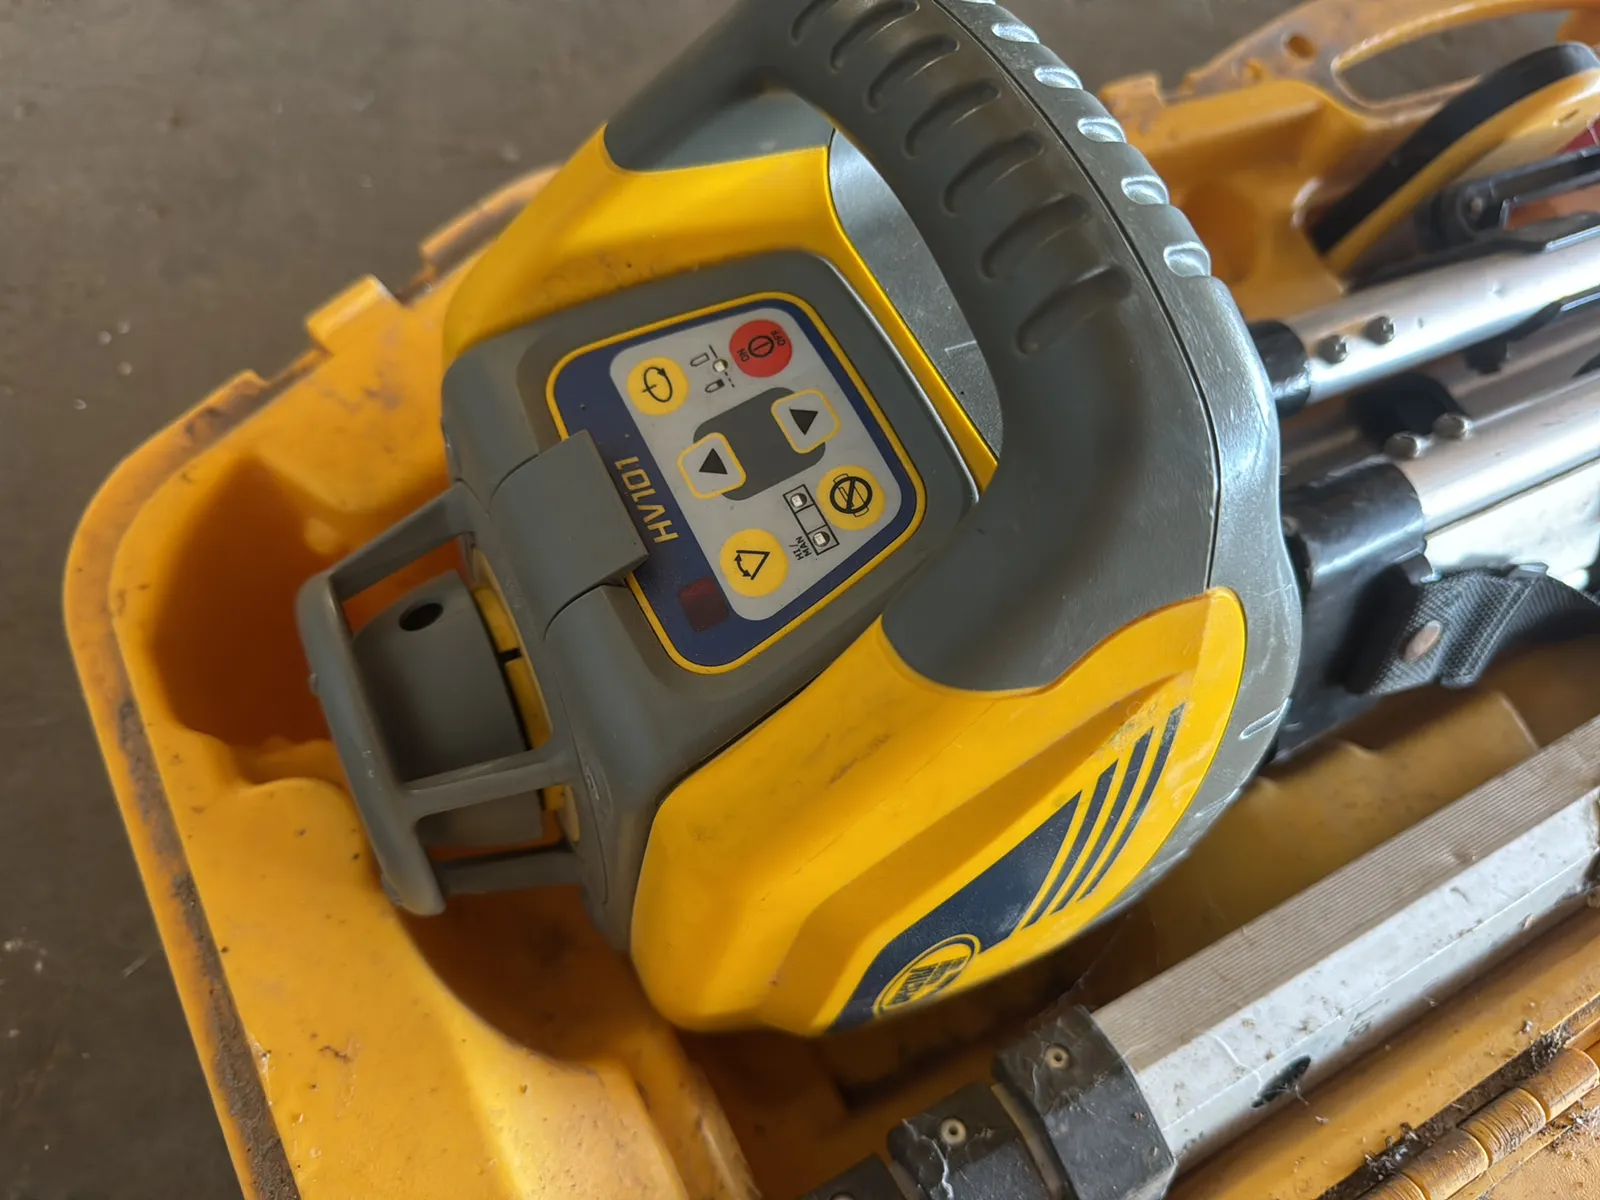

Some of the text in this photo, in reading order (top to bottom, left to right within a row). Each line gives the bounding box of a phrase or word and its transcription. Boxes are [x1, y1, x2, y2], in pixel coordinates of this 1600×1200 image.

[771, 330, 786, 346] OFF
[736, 348, 750, 362] ON
[614, 456, 679, 543] HV101
[795, 536, 812, 557] MAN
